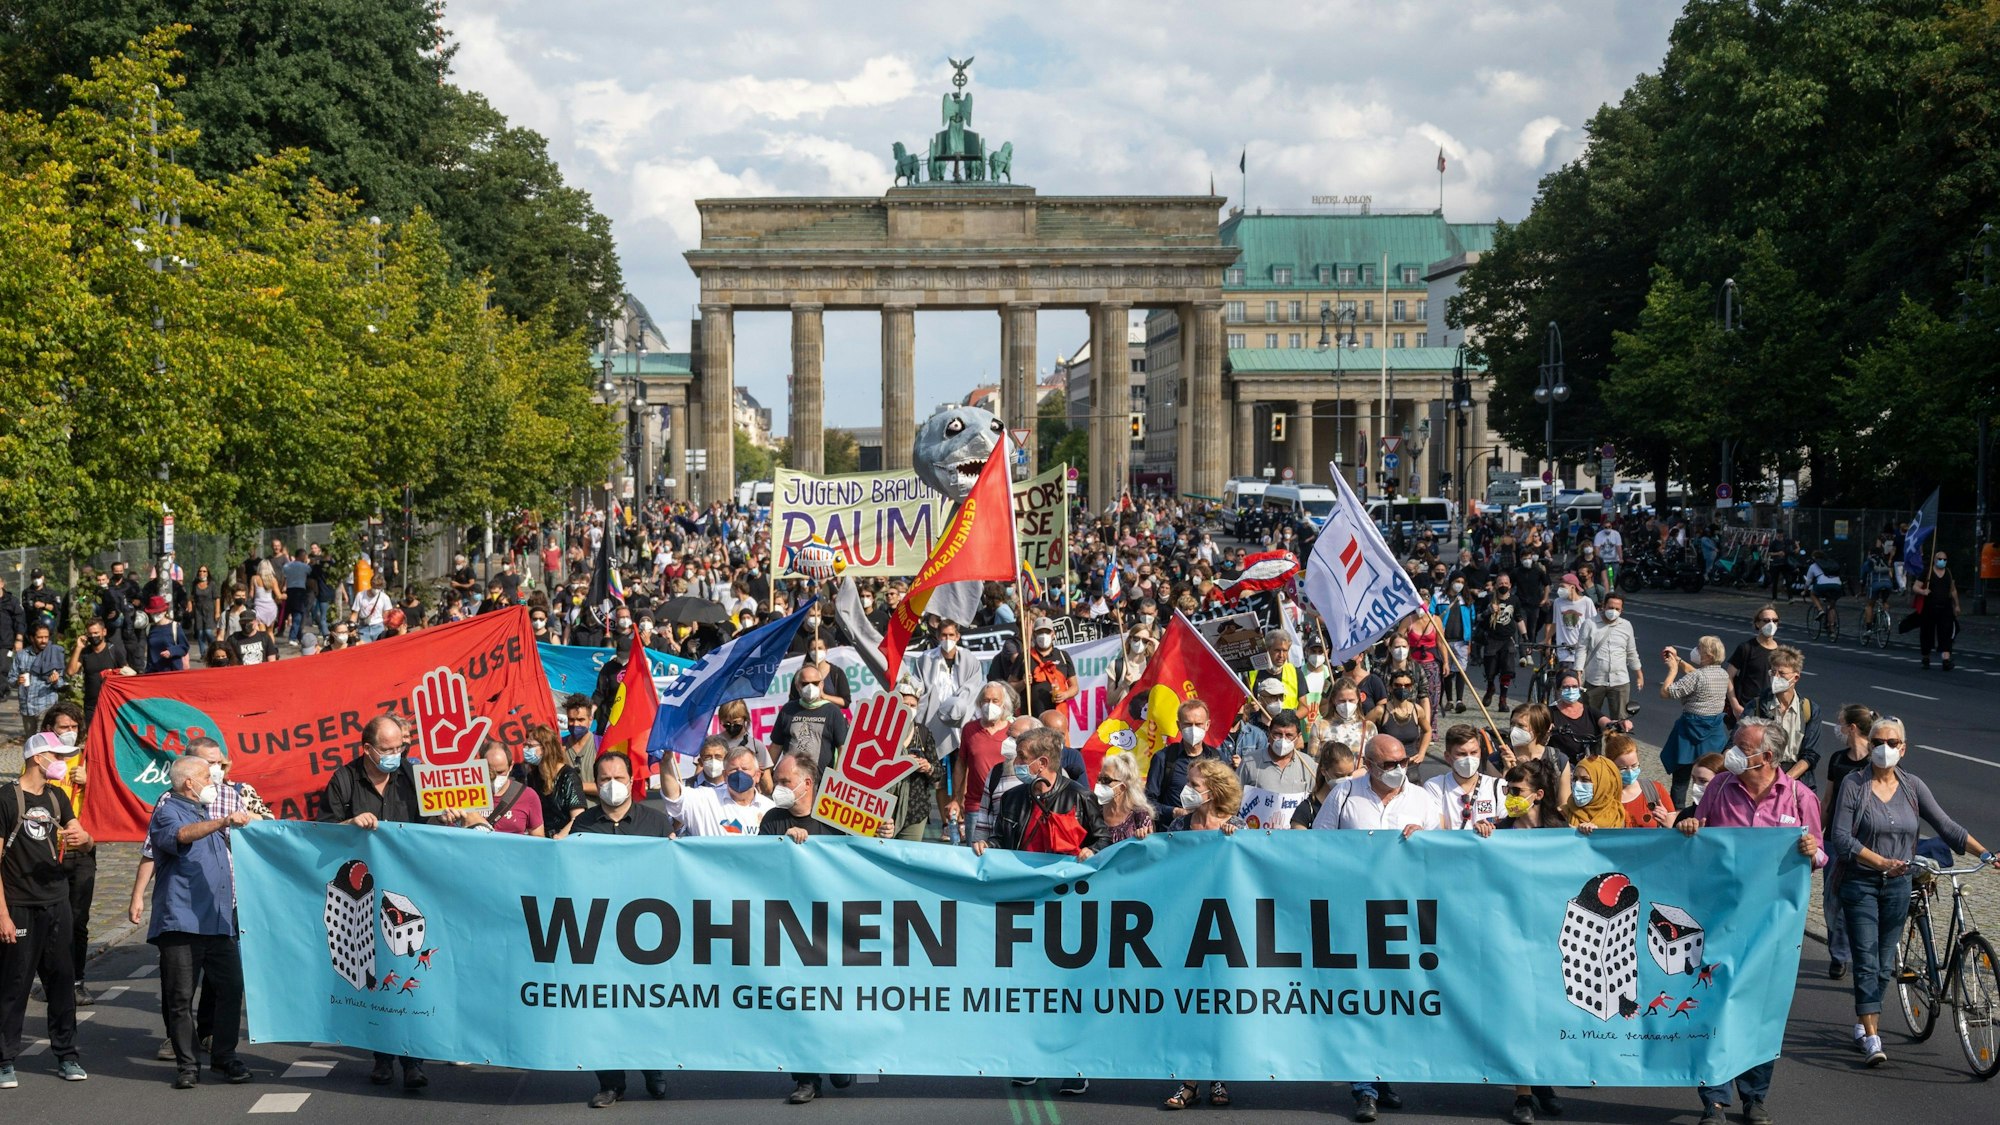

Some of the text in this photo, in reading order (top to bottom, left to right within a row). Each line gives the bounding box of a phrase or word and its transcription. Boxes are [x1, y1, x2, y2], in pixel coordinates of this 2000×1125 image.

[1311, 195, 1372, 204] HOTEL ADLON
[784, 478, 863, 505] JUGEND
[778, 503, 932, 568] RAUM
[237, 710, 364, 755] UNSER
[309, 741, 362, 775] IST
[420, 766, 484, 789] MIETEN
[423, 787, 487, 810] STOPP!
[824, 776, 889, 818] MIETEN
[520, 880, 1439, 970] WOHNEN FÜR ALLE!
[330, 995, 343, 1005] Die
[345, 997, 367, 1008] Miete
[519, 981, 1442, 1016] GEMEINSAM GEGEN HOHE MIETEN UND VERDRÄNGUNG
[1560, 1029, 1577, 1040] Die
[1583, 1029, 1618, 1040] Miete
